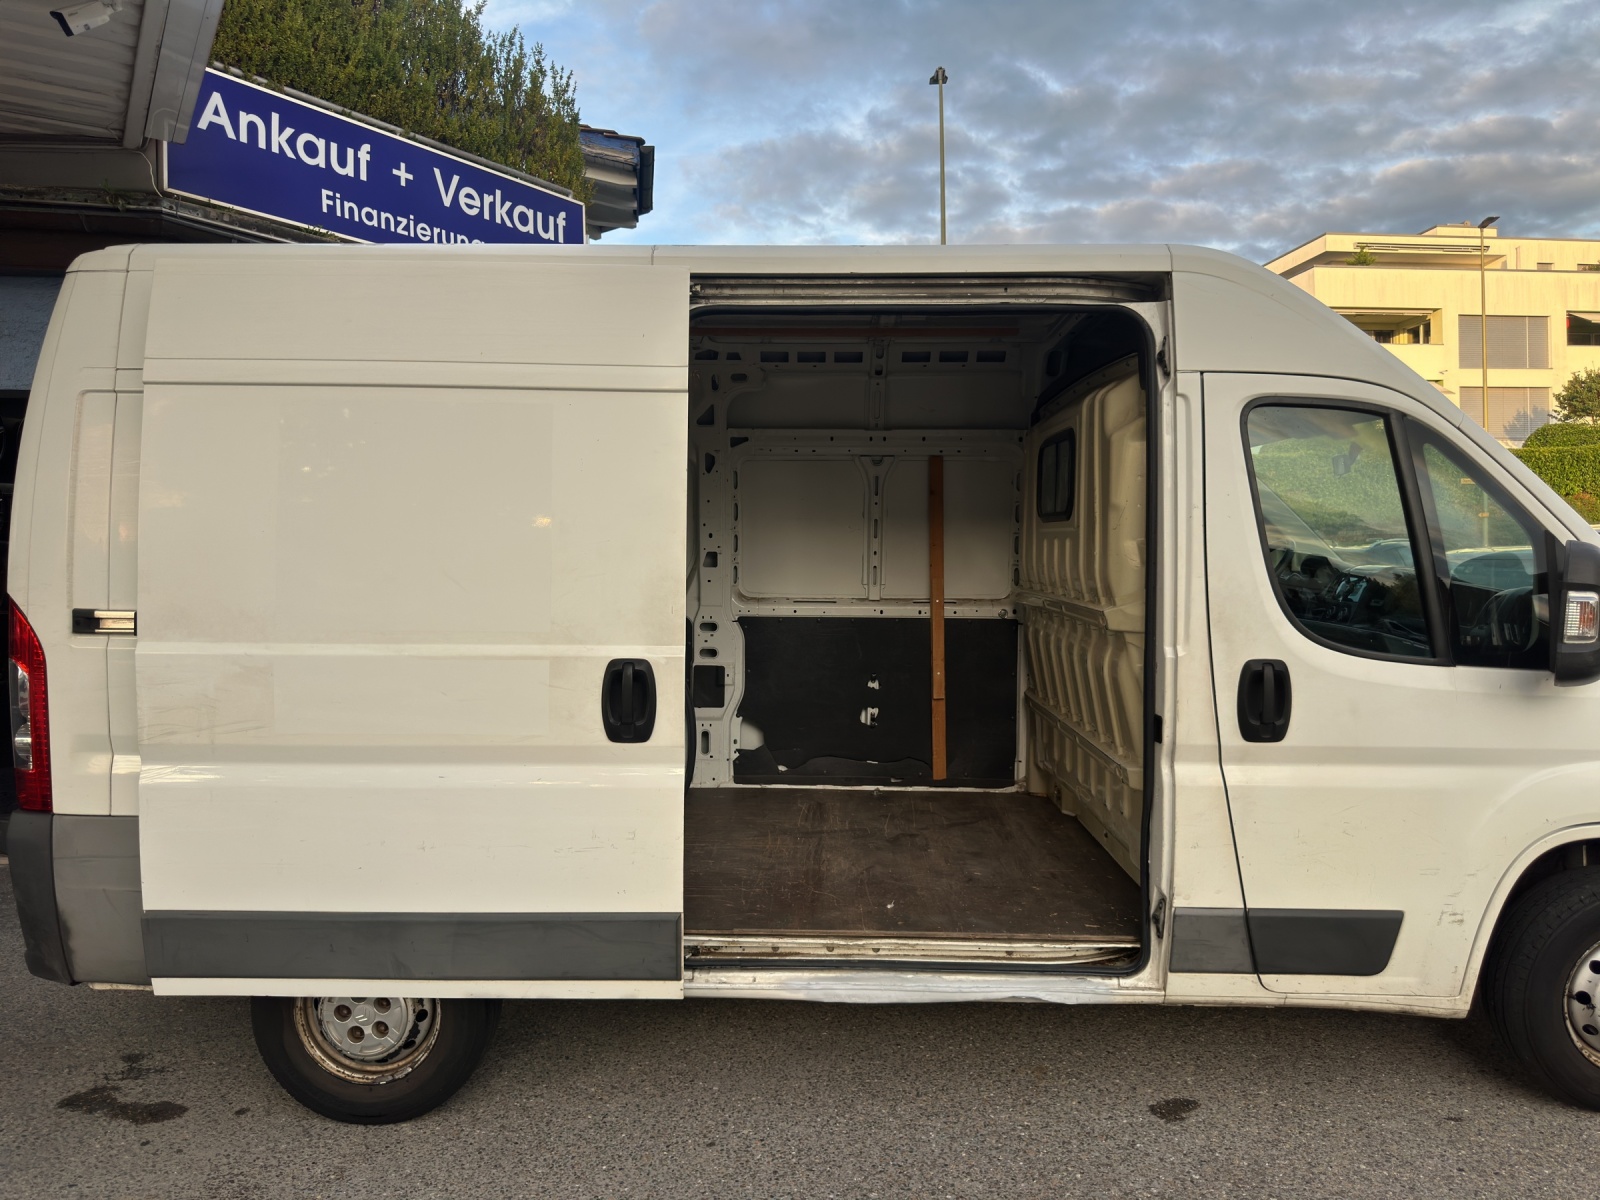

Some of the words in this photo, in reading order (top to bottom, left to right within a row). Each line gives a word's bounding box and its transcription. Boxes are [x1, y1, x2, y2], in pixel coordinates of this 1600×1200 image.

[197, 91, 371, 181] Ankauf
[393, 162, 413, 187] +
[434, 168, 566, 243] Verkauf
[321, 189, 485, 243] Finanzierun
